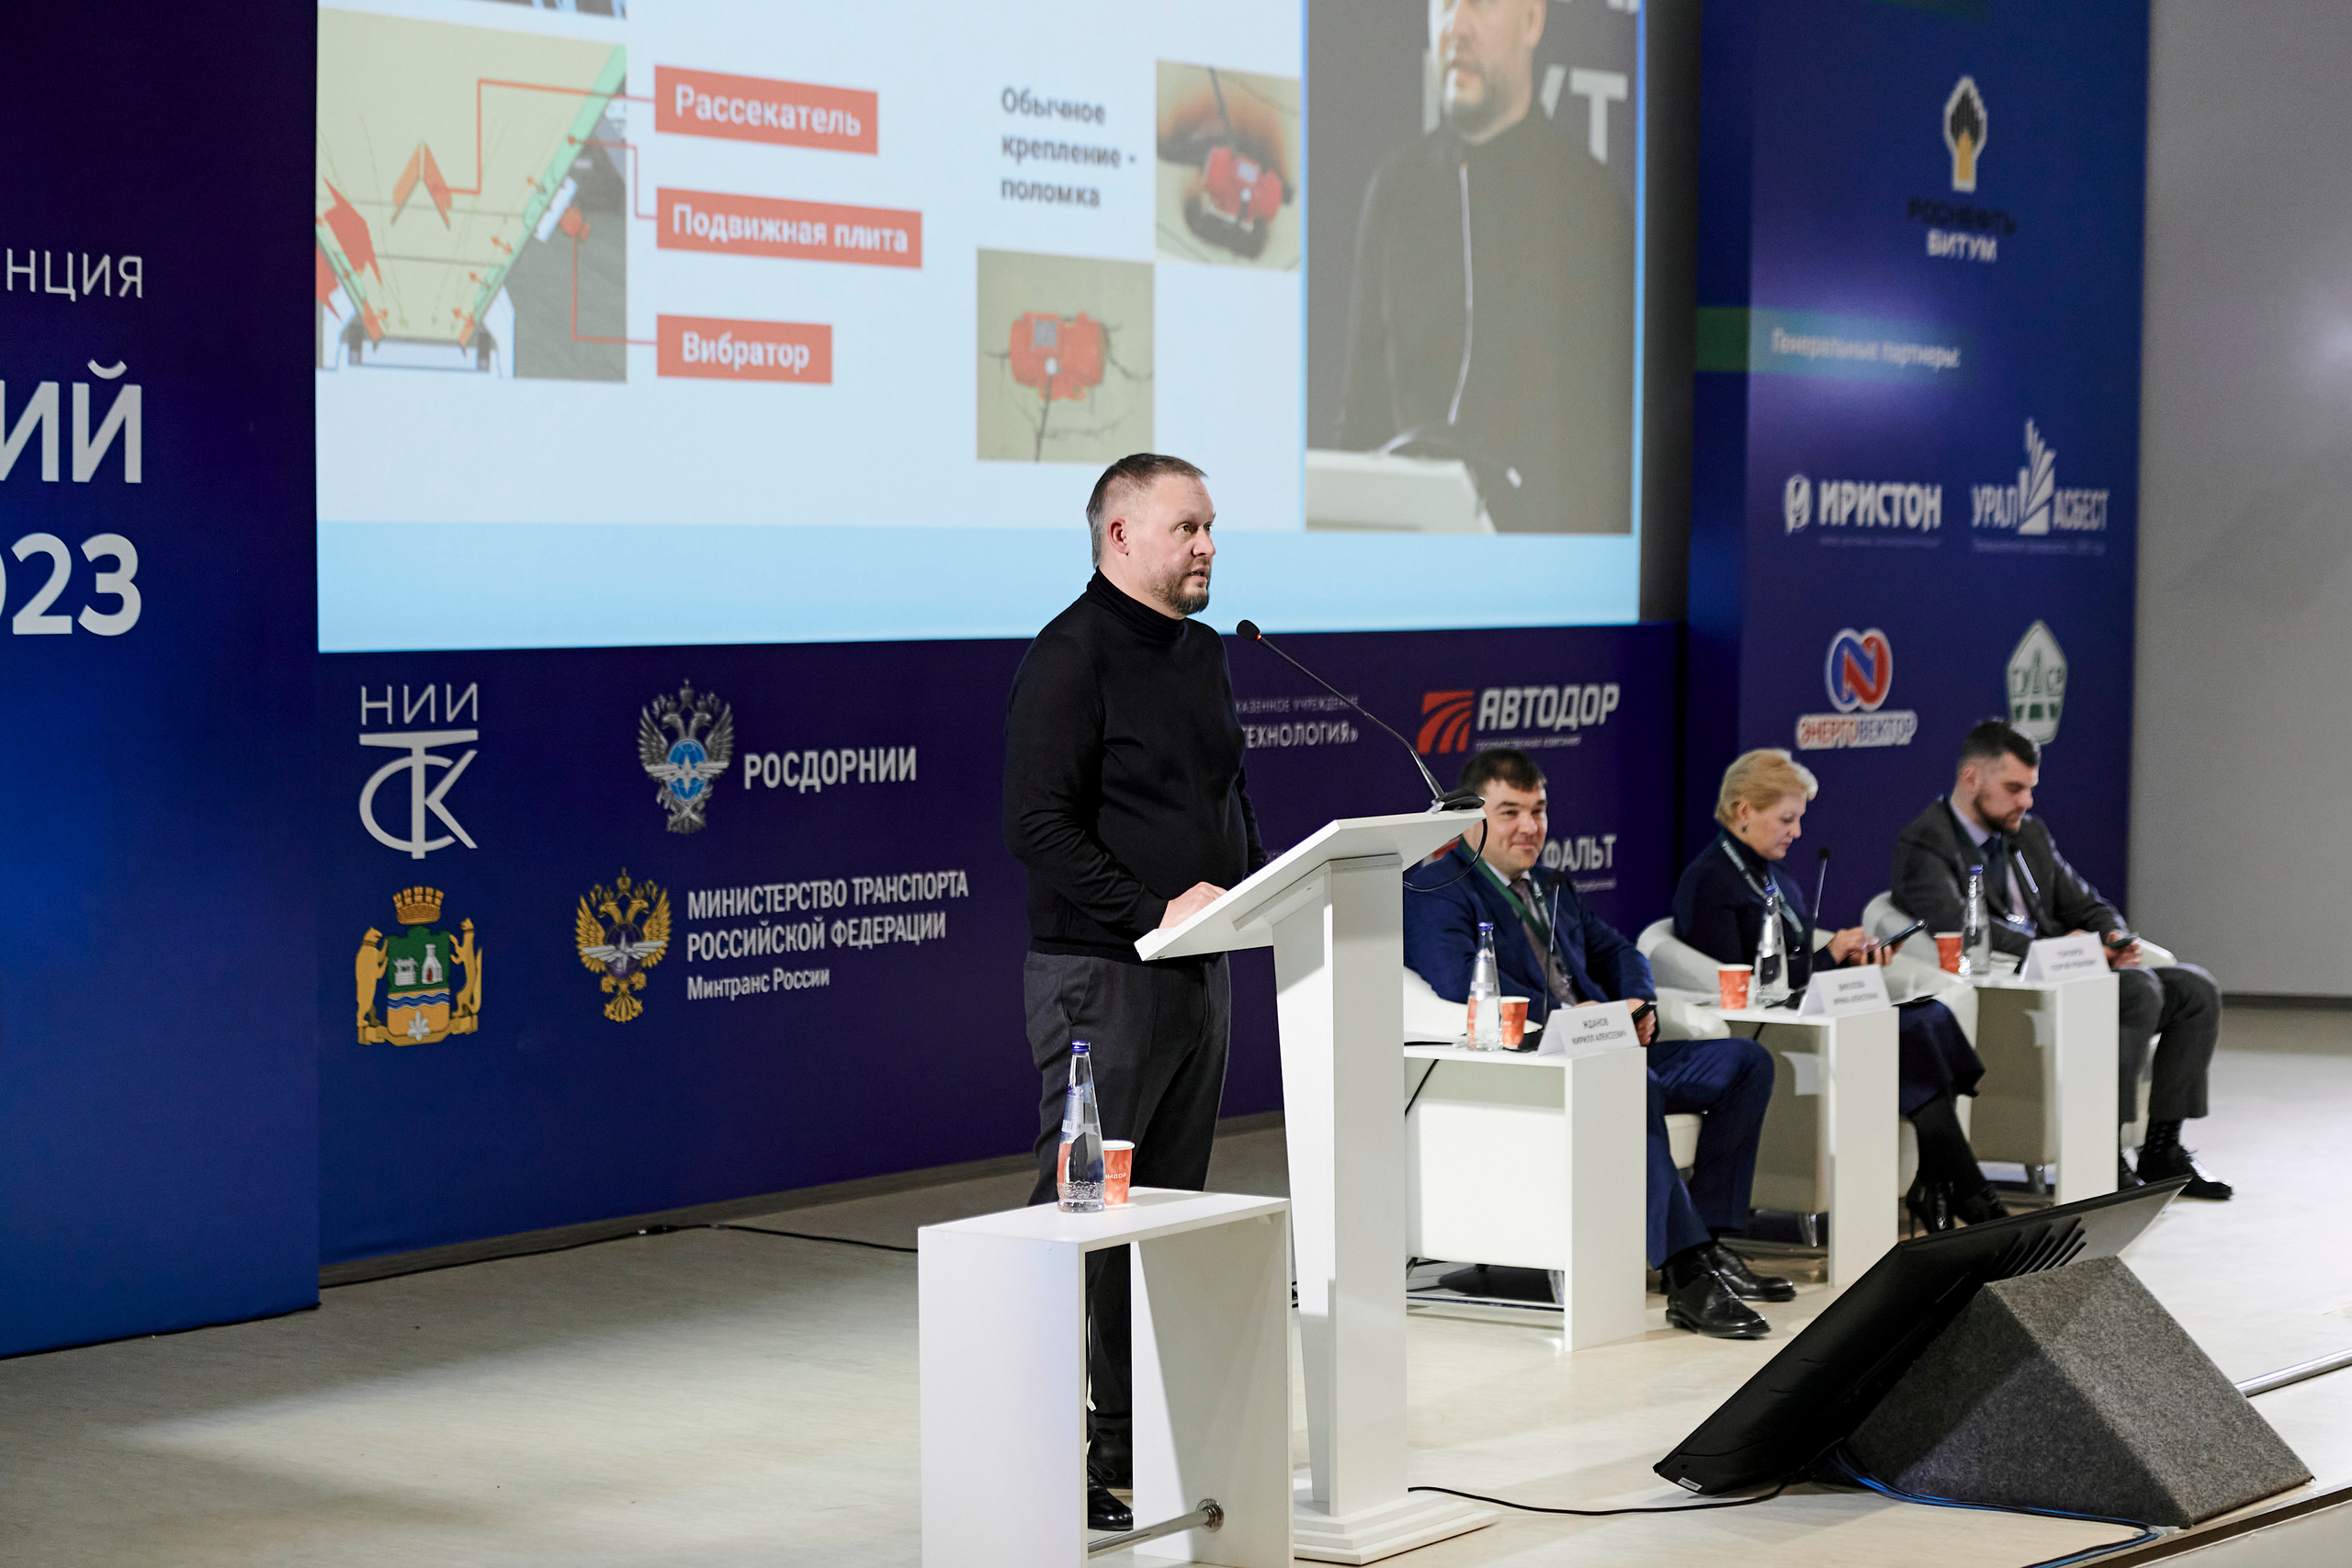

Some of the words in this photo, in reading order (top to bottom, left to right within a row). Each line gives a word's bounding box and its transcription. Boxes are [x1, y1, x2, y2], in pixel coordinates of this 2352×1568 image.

[673, 84, 862, 137] Рассекатель
[1001, 86, 1106, 125] Обычное
[1001, 132, 1121, 169] крепление
[1001, 176, 1101, 209] поломка
[673, 203, 828, 249] Подвижная
[833, 224, 909, 254] плита
[1927, 229, 1997, 262] БИТУМ
[6, 247, 142, 302] НЦИЯ
[682, 331, 809, 375] Вибратор
[1818, 479, 1942, 533] ИРИСТОН
[1971, 484, 2018, 528] УРАЛ
[0, 532, 142, 637] 23
[360, 682, 479, 726] НИИ
[1476, 682, 1621, 732] АВТОДОР
[743, 746, 918, 794] РОСДОРНИИ
[687, 878, 847, 919] МИНИСТЕРСТВО
[852, 870, 969, 907] ТРАНСПОРТА
[687, 916, 825, 962] РОССИЙСКОЙ
[831, 911, 946, 950] ФЕДЕРАЦИИ
[687, 974, 770, 1001] Минтранс
[773, 967, 831, 991] России
